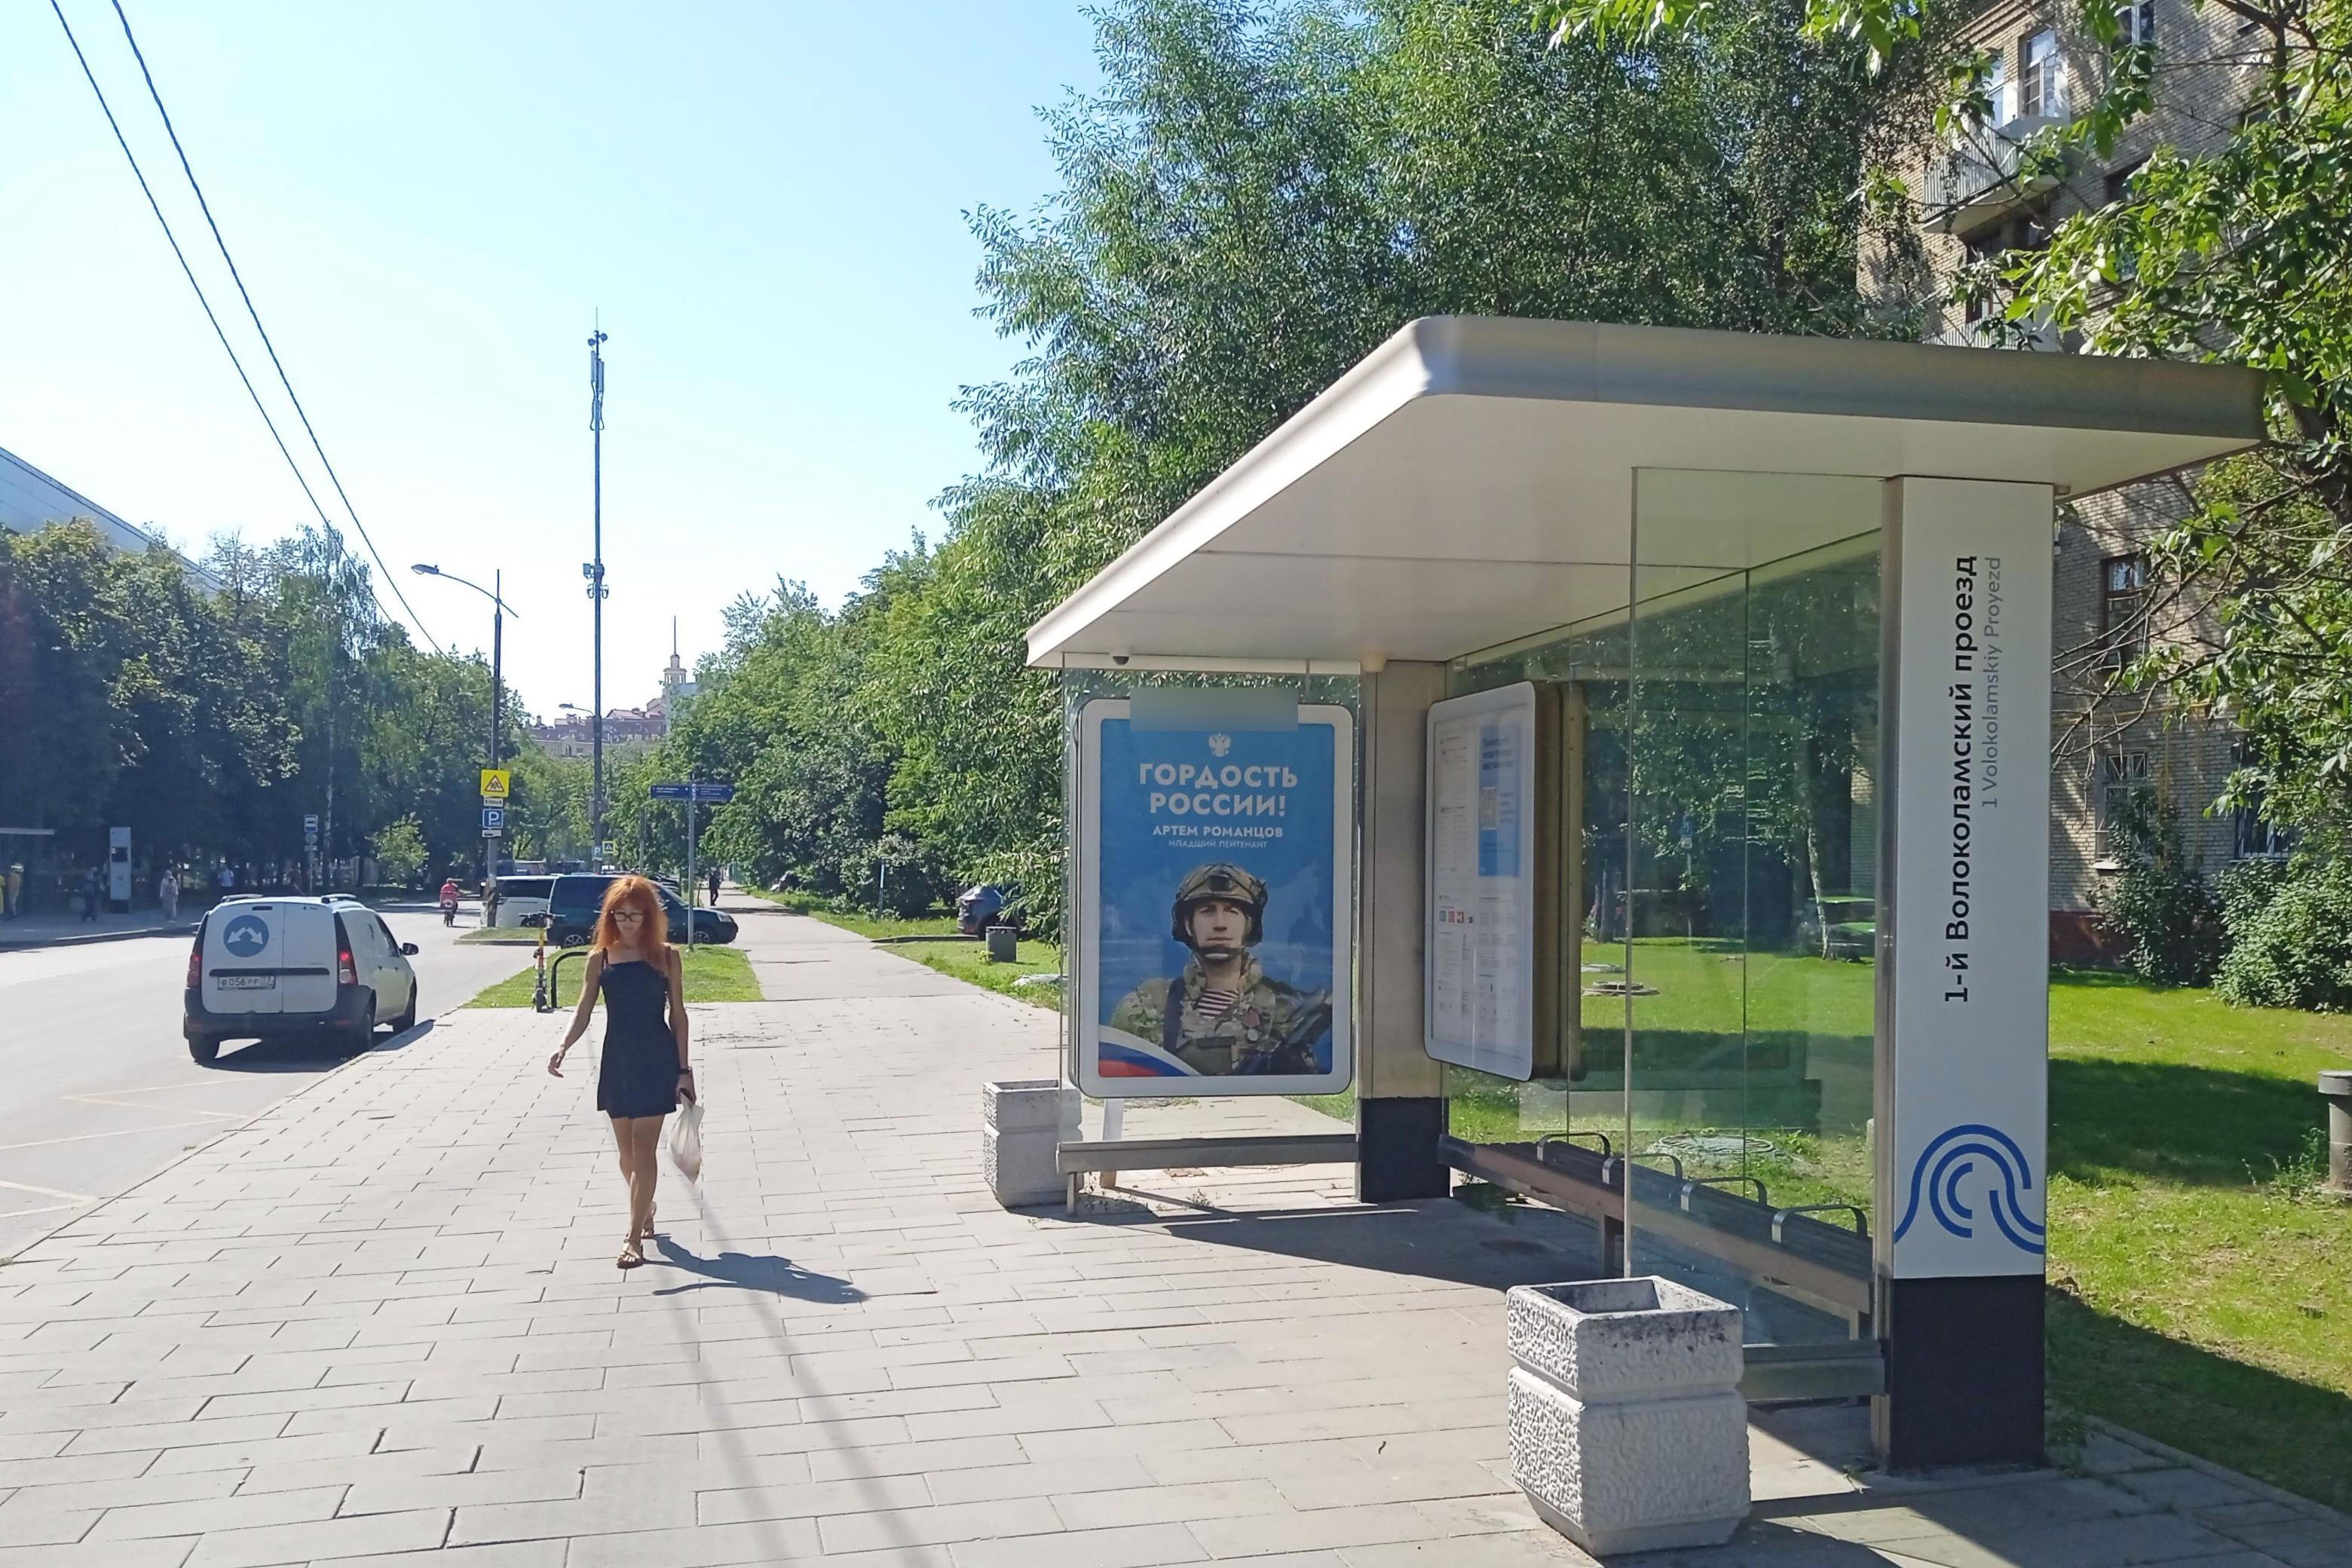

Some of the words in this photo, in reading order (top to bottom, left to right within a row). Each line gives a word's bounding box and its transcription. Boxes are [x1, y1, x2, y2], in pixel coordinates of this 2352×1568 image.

[1955, 556, 1978, 671] проезд
[1983, 557, 2003, 637] Proyezd
[1982, 644, 2002, 791] Volokolamskiy
[1139, 763, 1298, 789] ГОРДОСТЬ
[1150, 792, 1286, 817] РОССИИ!
[1946, 684, 1972, 939] Волоколамский
[1152, 825, 1199, 836] АРТЕМ
[1203, 825, 1283, 838] РОМАНЦОВ
[1168, 839, 1216, 848] МЛАДШИЙ
[1219, 840, 1267, 848] ЛЕЙТЕНАНТ
[1945, 954, 1968, 1002] 1-й
